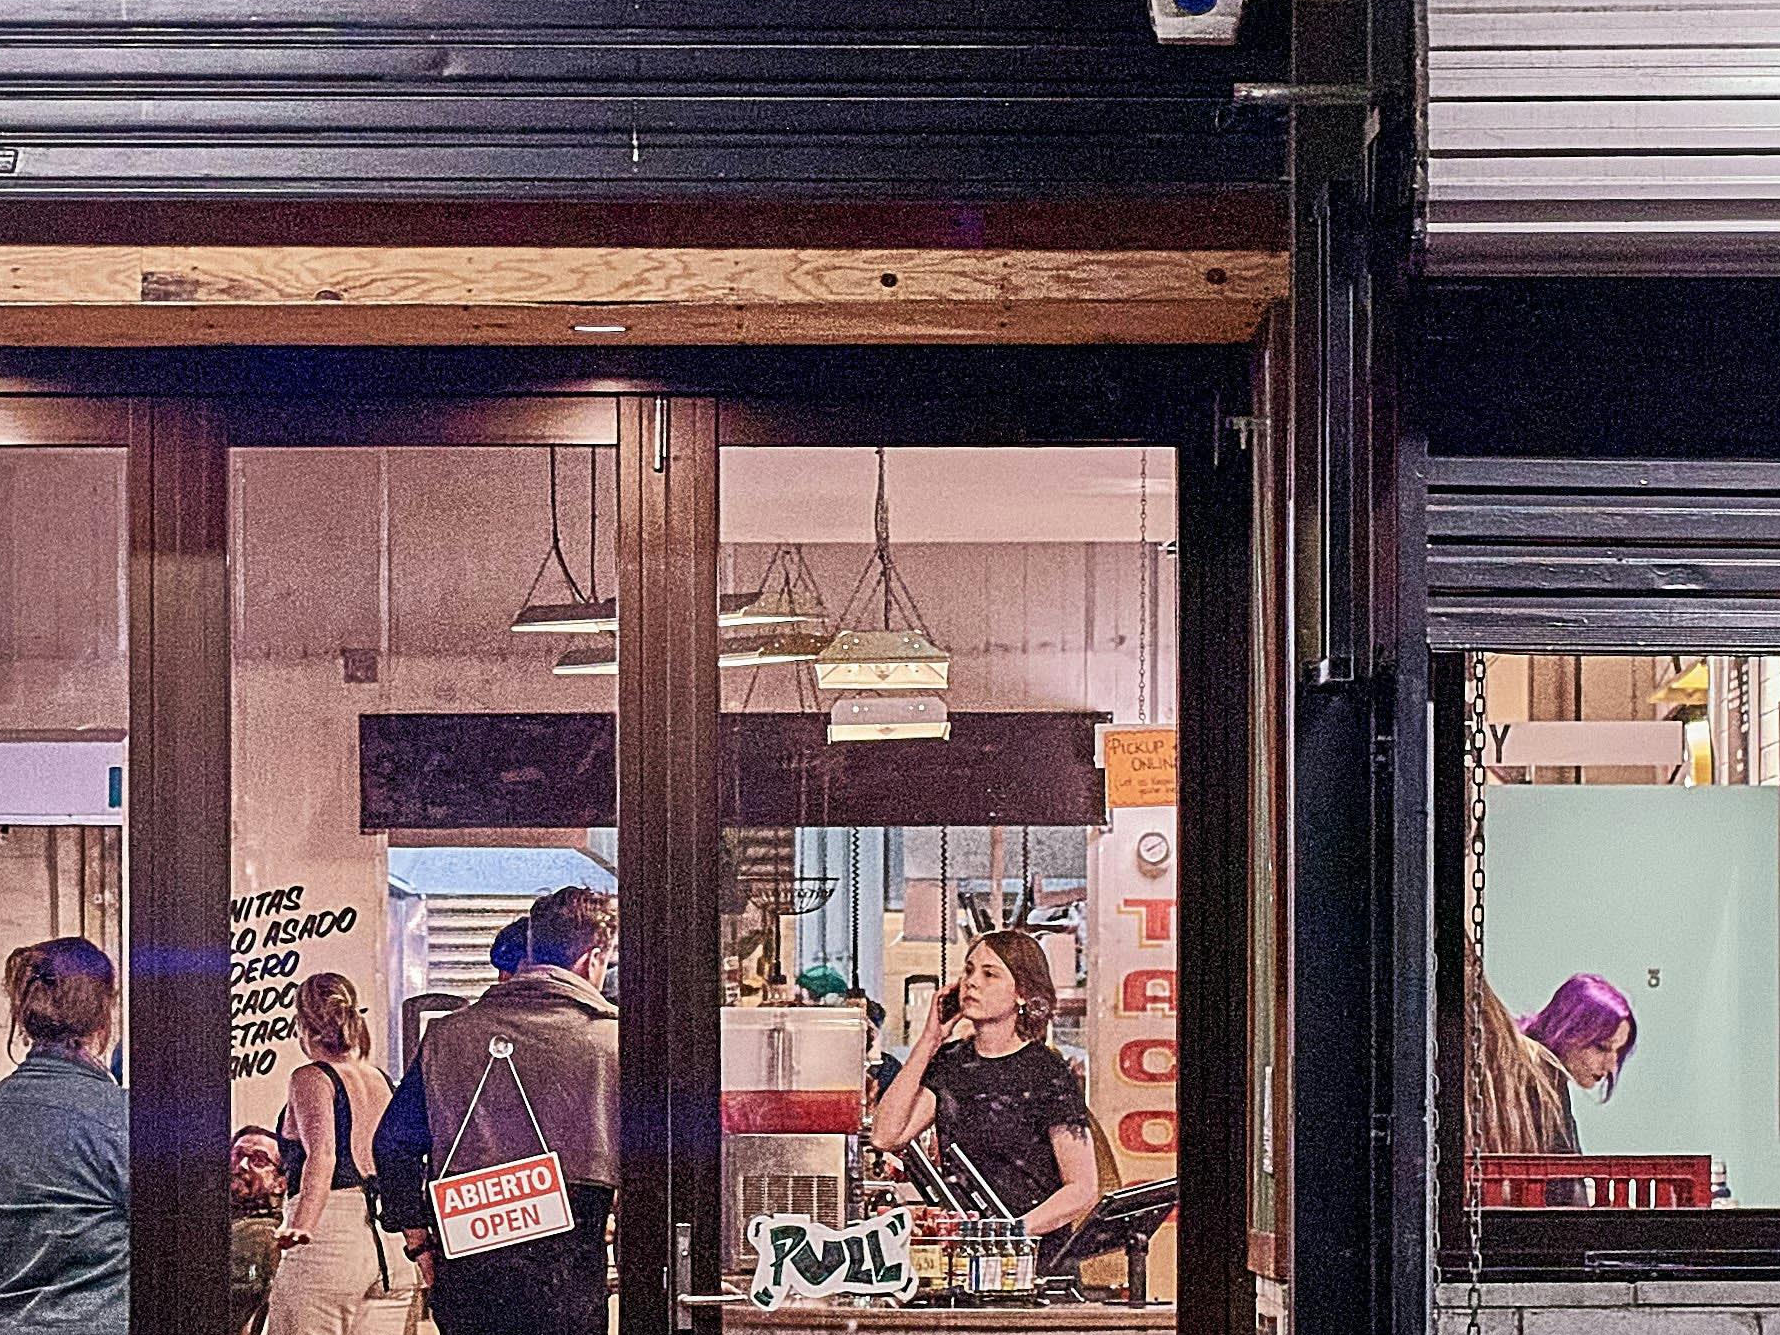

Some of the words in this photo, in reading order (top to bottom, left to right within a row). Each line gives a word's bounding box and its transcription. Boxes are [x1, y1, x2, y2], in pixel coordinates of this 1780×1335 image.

[1131, 756, 1177, 772] ONLIN
[262, 906, 357, 949] ASADO
[443, 1166, 553, 1214] ABIERTO
[469, 1203, 541, 1240] OPEN
